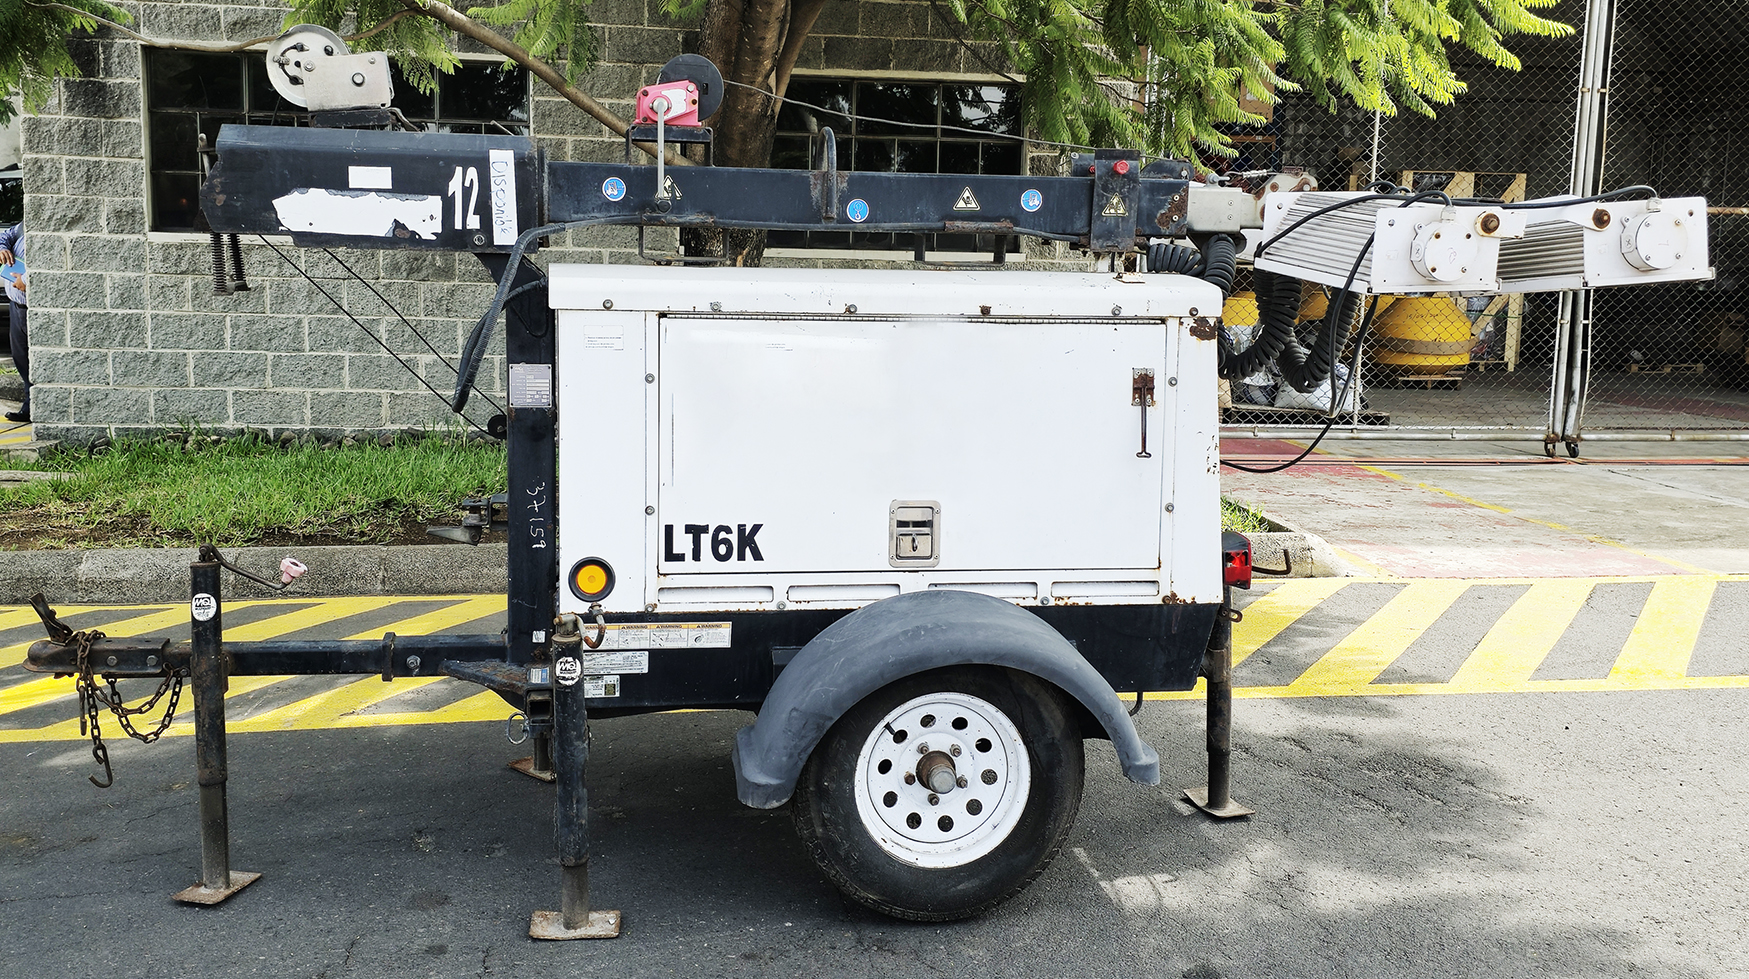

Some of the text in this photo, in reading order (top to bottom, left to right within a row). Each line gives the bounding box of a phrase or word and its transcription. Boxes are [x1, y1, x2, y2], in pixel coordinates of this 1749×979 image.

[448, 166, 480, 230] 12
[526, 482, 547, 549] 37159
[664, 524, 765, 562] LT6K
